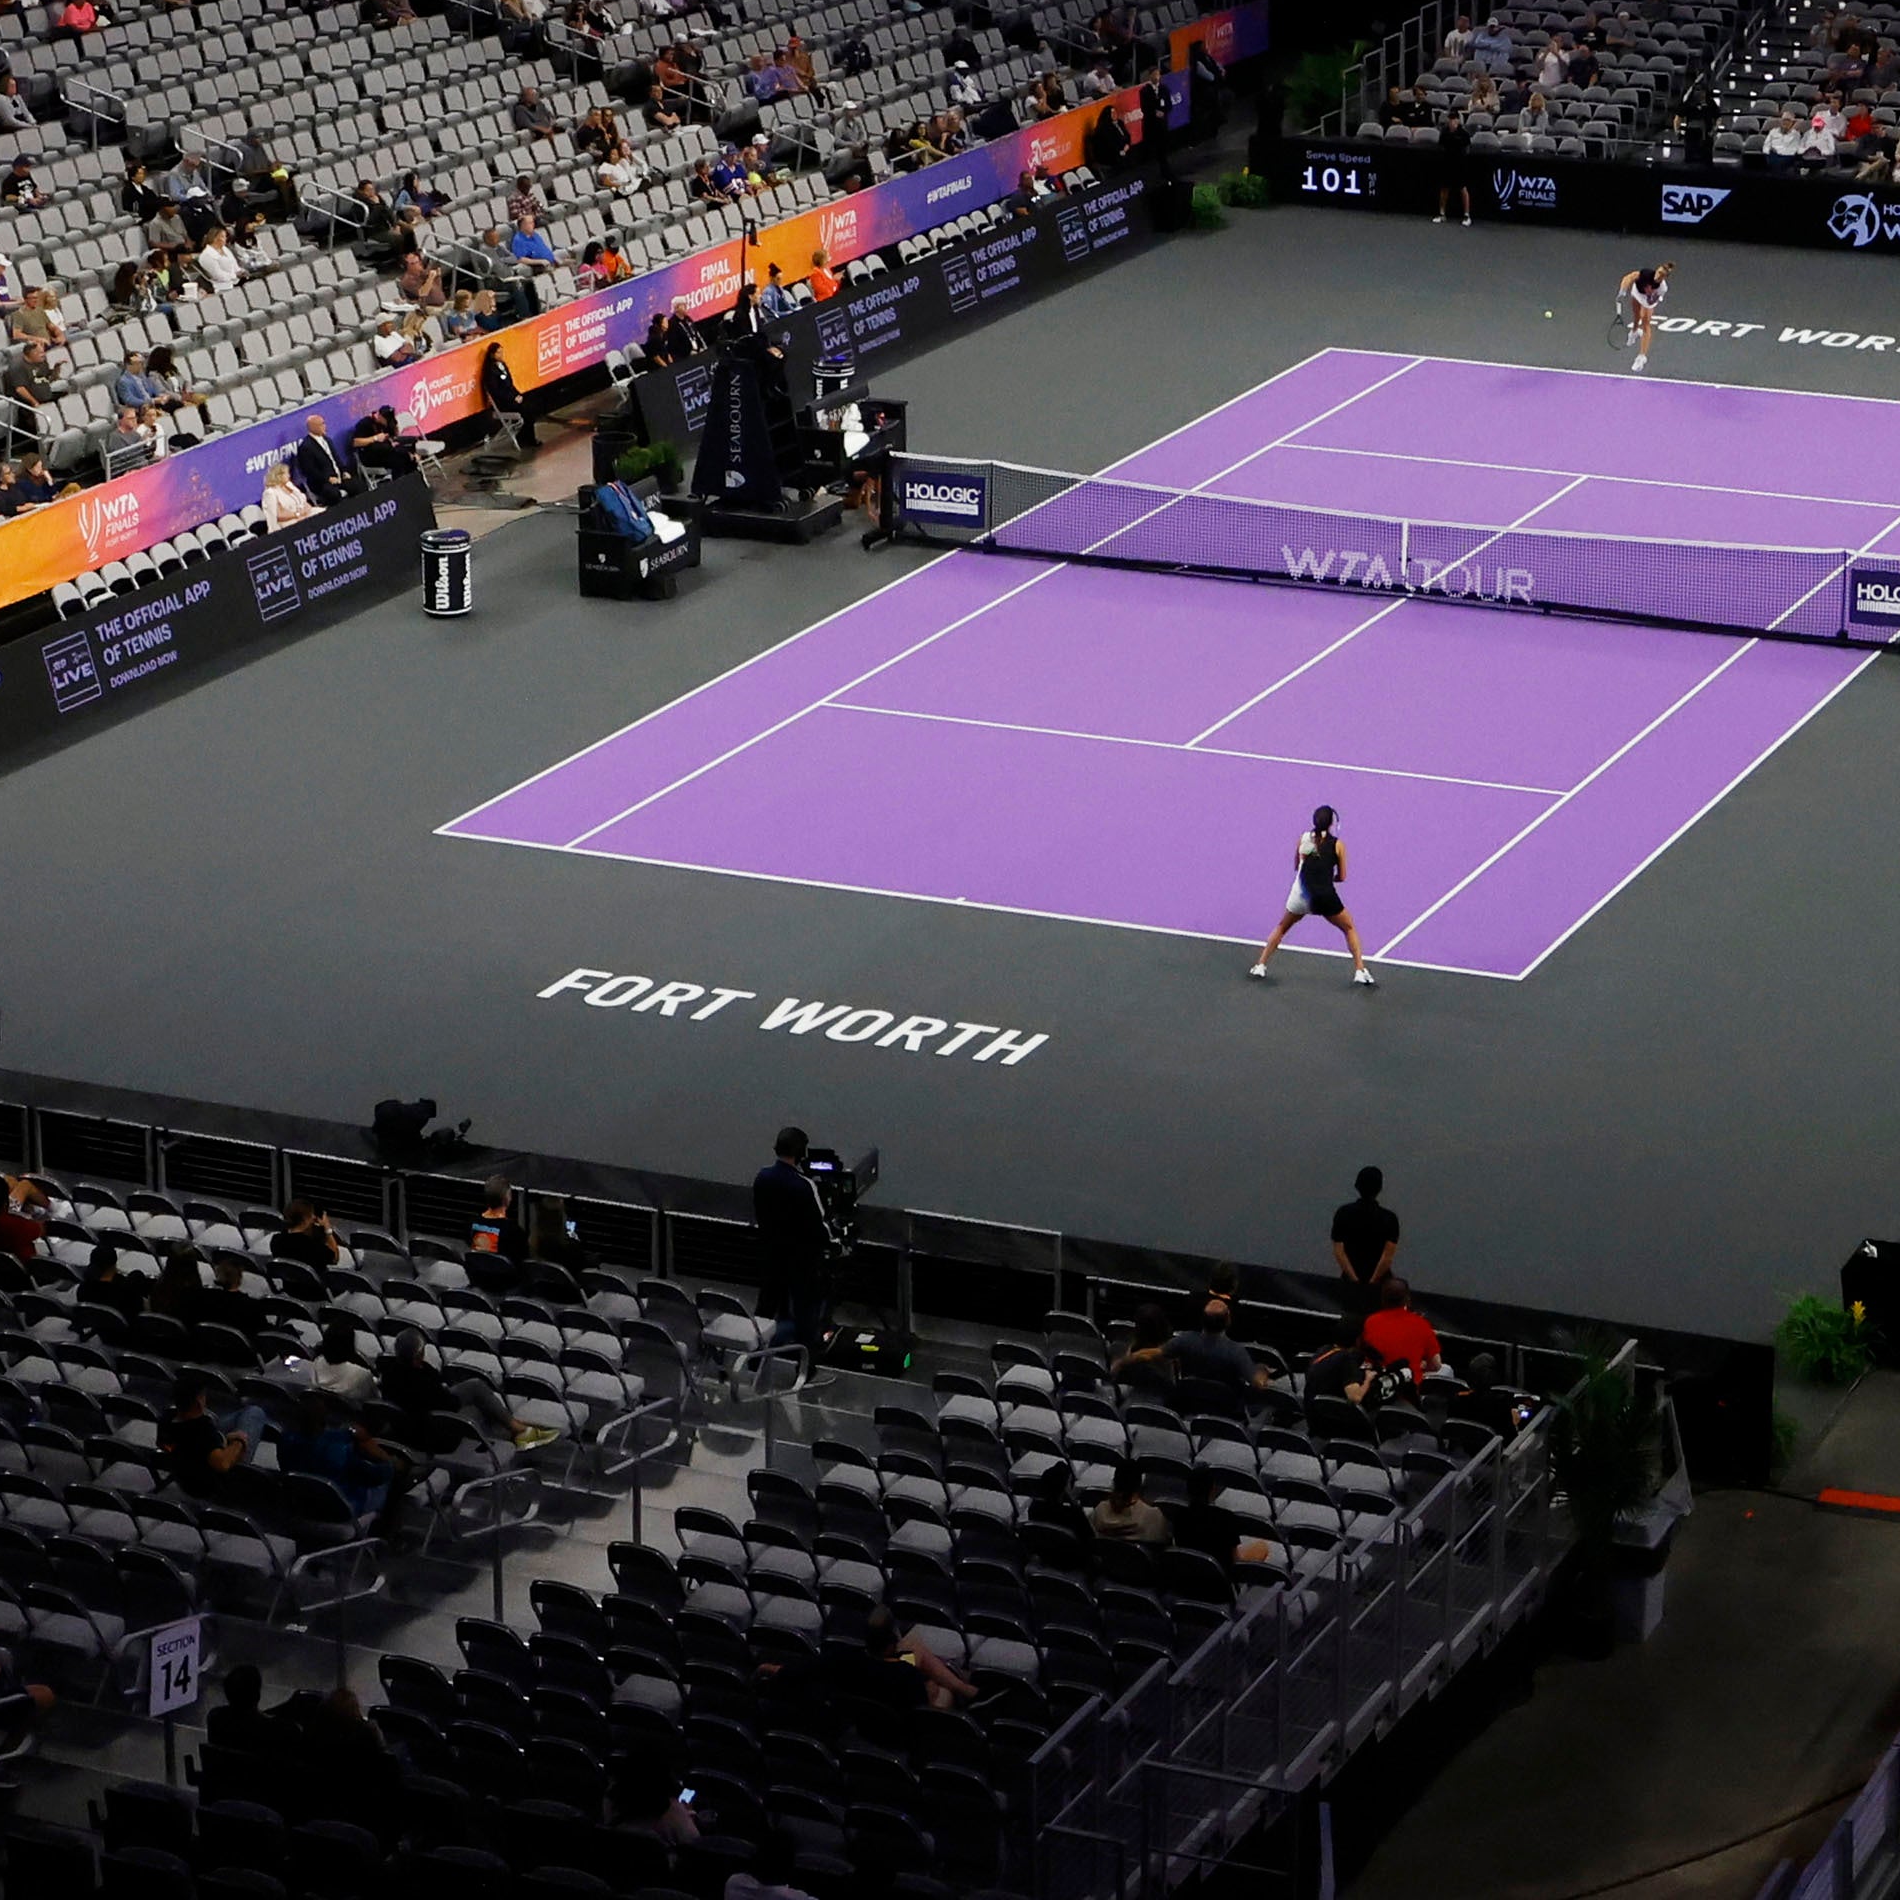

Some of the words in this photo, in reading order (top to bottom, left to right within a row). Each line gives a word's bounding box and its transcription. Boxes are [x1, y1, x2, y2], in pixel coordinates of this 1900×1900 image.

[1306, 150, 1336, 162] Serve
[1339, 153, 1371, 164] Speed
[927, 175, 973, 204] #WTAFINALS
[1302, 166, 1361, 195] 101
[1518, 175, 1556, 191] WTA
[1518, 189, 1556, 201] FINALS
[1663, 192, 1714, 217] SAP
[700, 258, 731, 279] FINAL
[565, 312, 581, 331] THE
[582, 303, 615, 326] OFFICIAL
[616, 297, 634, 315] APP
[731, 374, 741, 463] SEABOURN
[102, 492, 139, 521] WTA
[905, 482, 980, 504] HOLOGIC
[105, 512, 140, 537] FINALS
[294, 533, 319, 556] THE
[320, 512, 372, 544] OFFICIAL
[374, 499, 397, 522] APP
[301, 560, 320, 580] OF
[322, 540, 363, 573] TENNIS
[650, 543, 689, 571] SEABOURN
[1283, 545, 1394, 589] WTA
[256, 574, 293, 600] LIVE
[435, 555, 450, 610] Wilson
[96, 618, 124, 643] THE
[125, 595, 182, 629] OFFICIAL
[185, 579, 211, 606] APP
[103, 646, 123, 666] OF
[126, 624, 172, 659] TENNIS
[53, 662, 93, 690] LIVE
[536, 968, 757, 1021] FORT
[759, 998, 1050, 1066] WORTH
[156, 1635, 196, 1659] SECTION
[160, 1654, 192, 1698] 14
